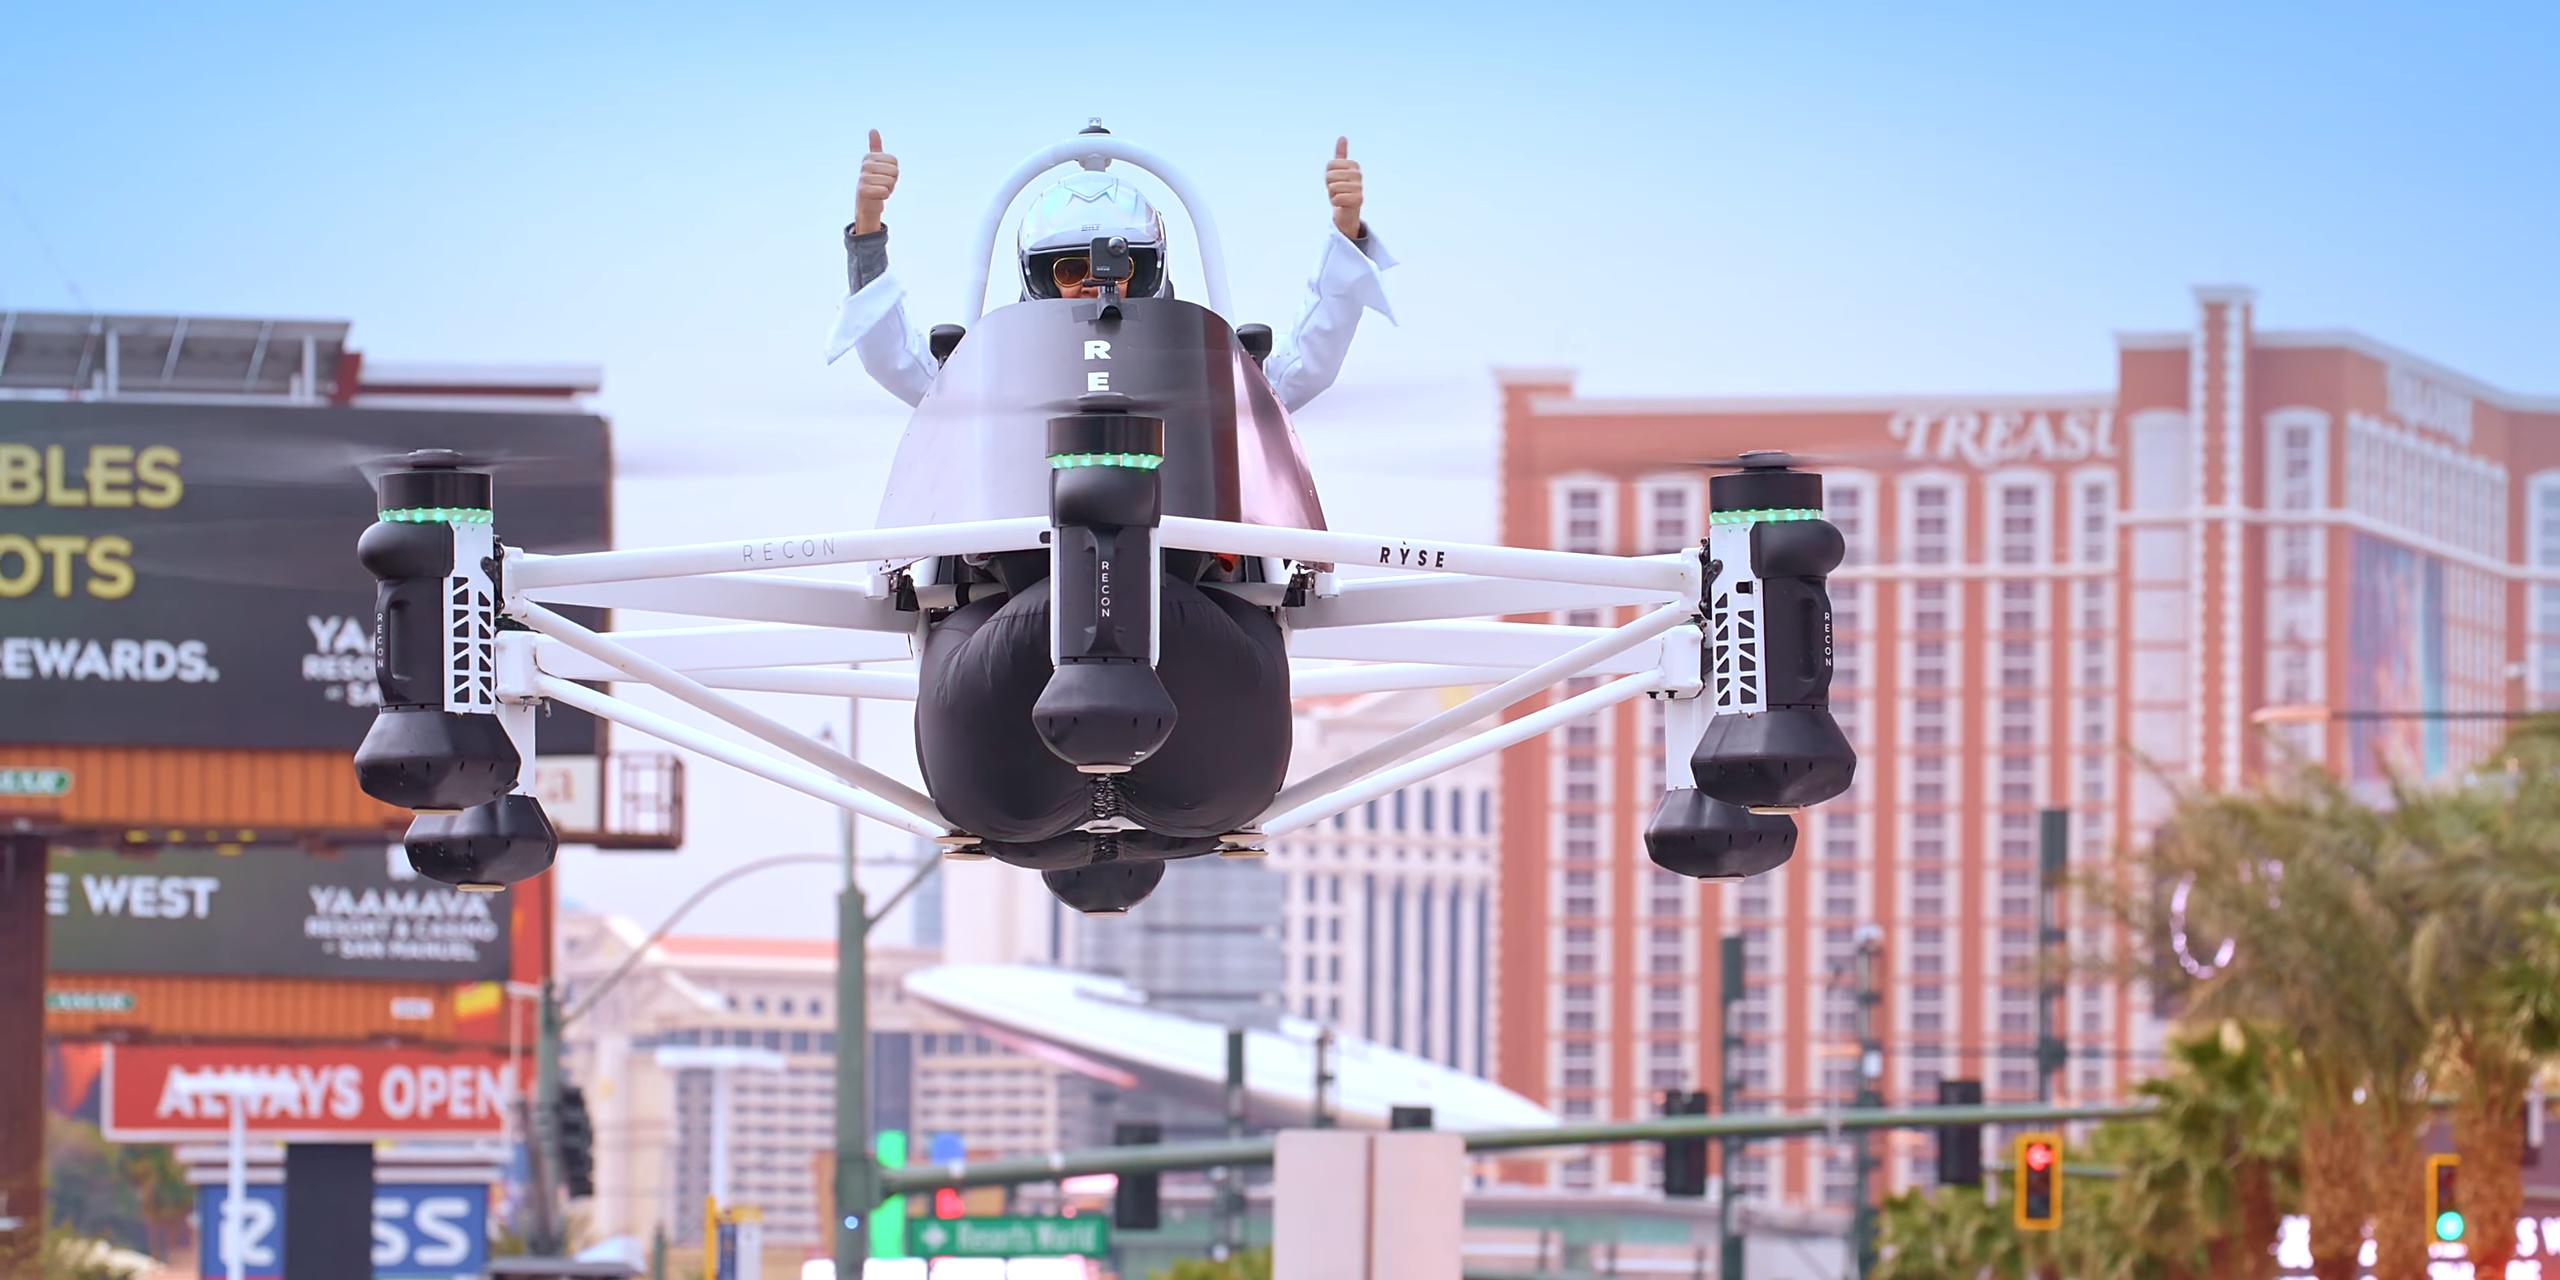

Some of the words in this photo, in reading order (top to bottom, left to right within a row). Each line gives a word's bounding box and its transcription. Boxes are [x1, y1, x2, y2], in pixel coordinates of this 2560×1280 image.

[0, 534, 135, 599] OTS
[743, 538, 834, 562] RECON
[1101, 560, 1111, 618] RECON
[0, 636, 220, 683] EWARDS.
[306, 614, 376, 653] YA
[376, 612, 384, 668] RECON
[1824, 611, 1832, 667] RECON
[81, 873, 219, 919] WEST
[379, 1064, 513, 1119] OPEN
